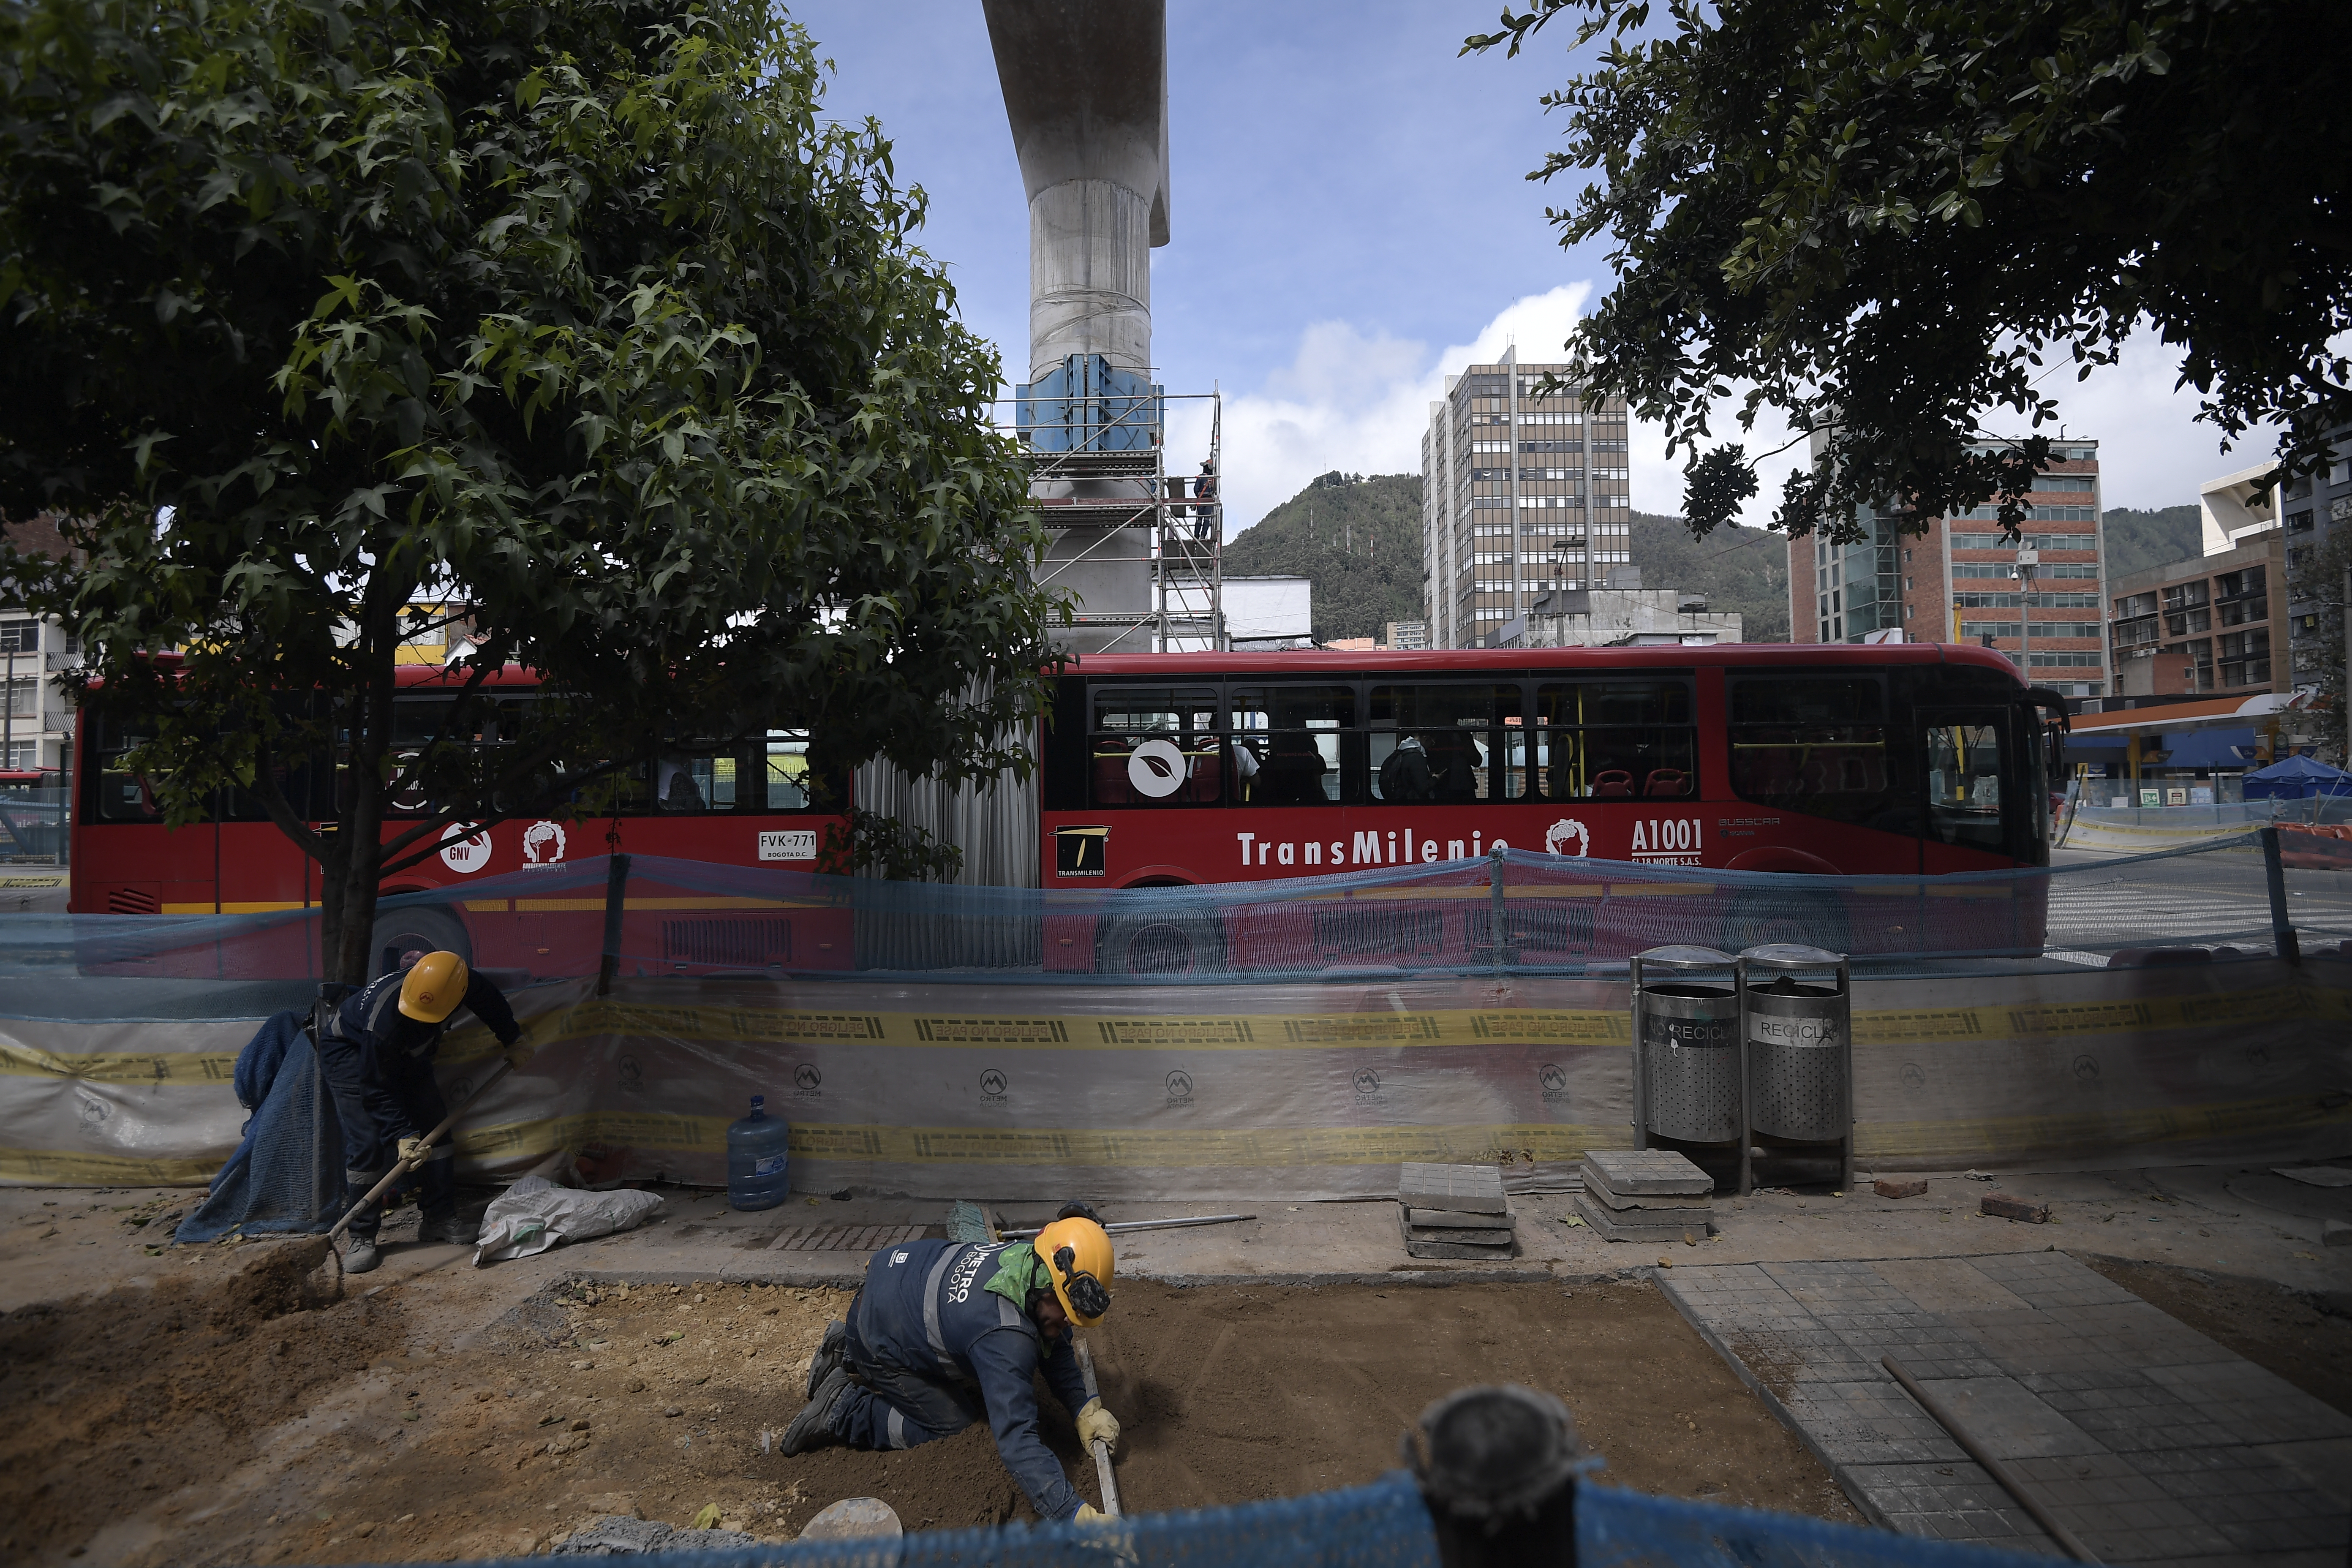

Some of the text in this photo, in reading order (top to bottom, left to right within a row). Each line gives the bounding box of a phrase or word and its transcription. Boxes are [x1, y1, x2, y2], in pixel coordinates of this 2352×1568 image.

[1631, 819, 1701, 849] A1001
[449, 847, 470, 860] GNV
[1680, 857, 1702, 866] S.A.S.
[957, 1251, 990, 1304] METRO
